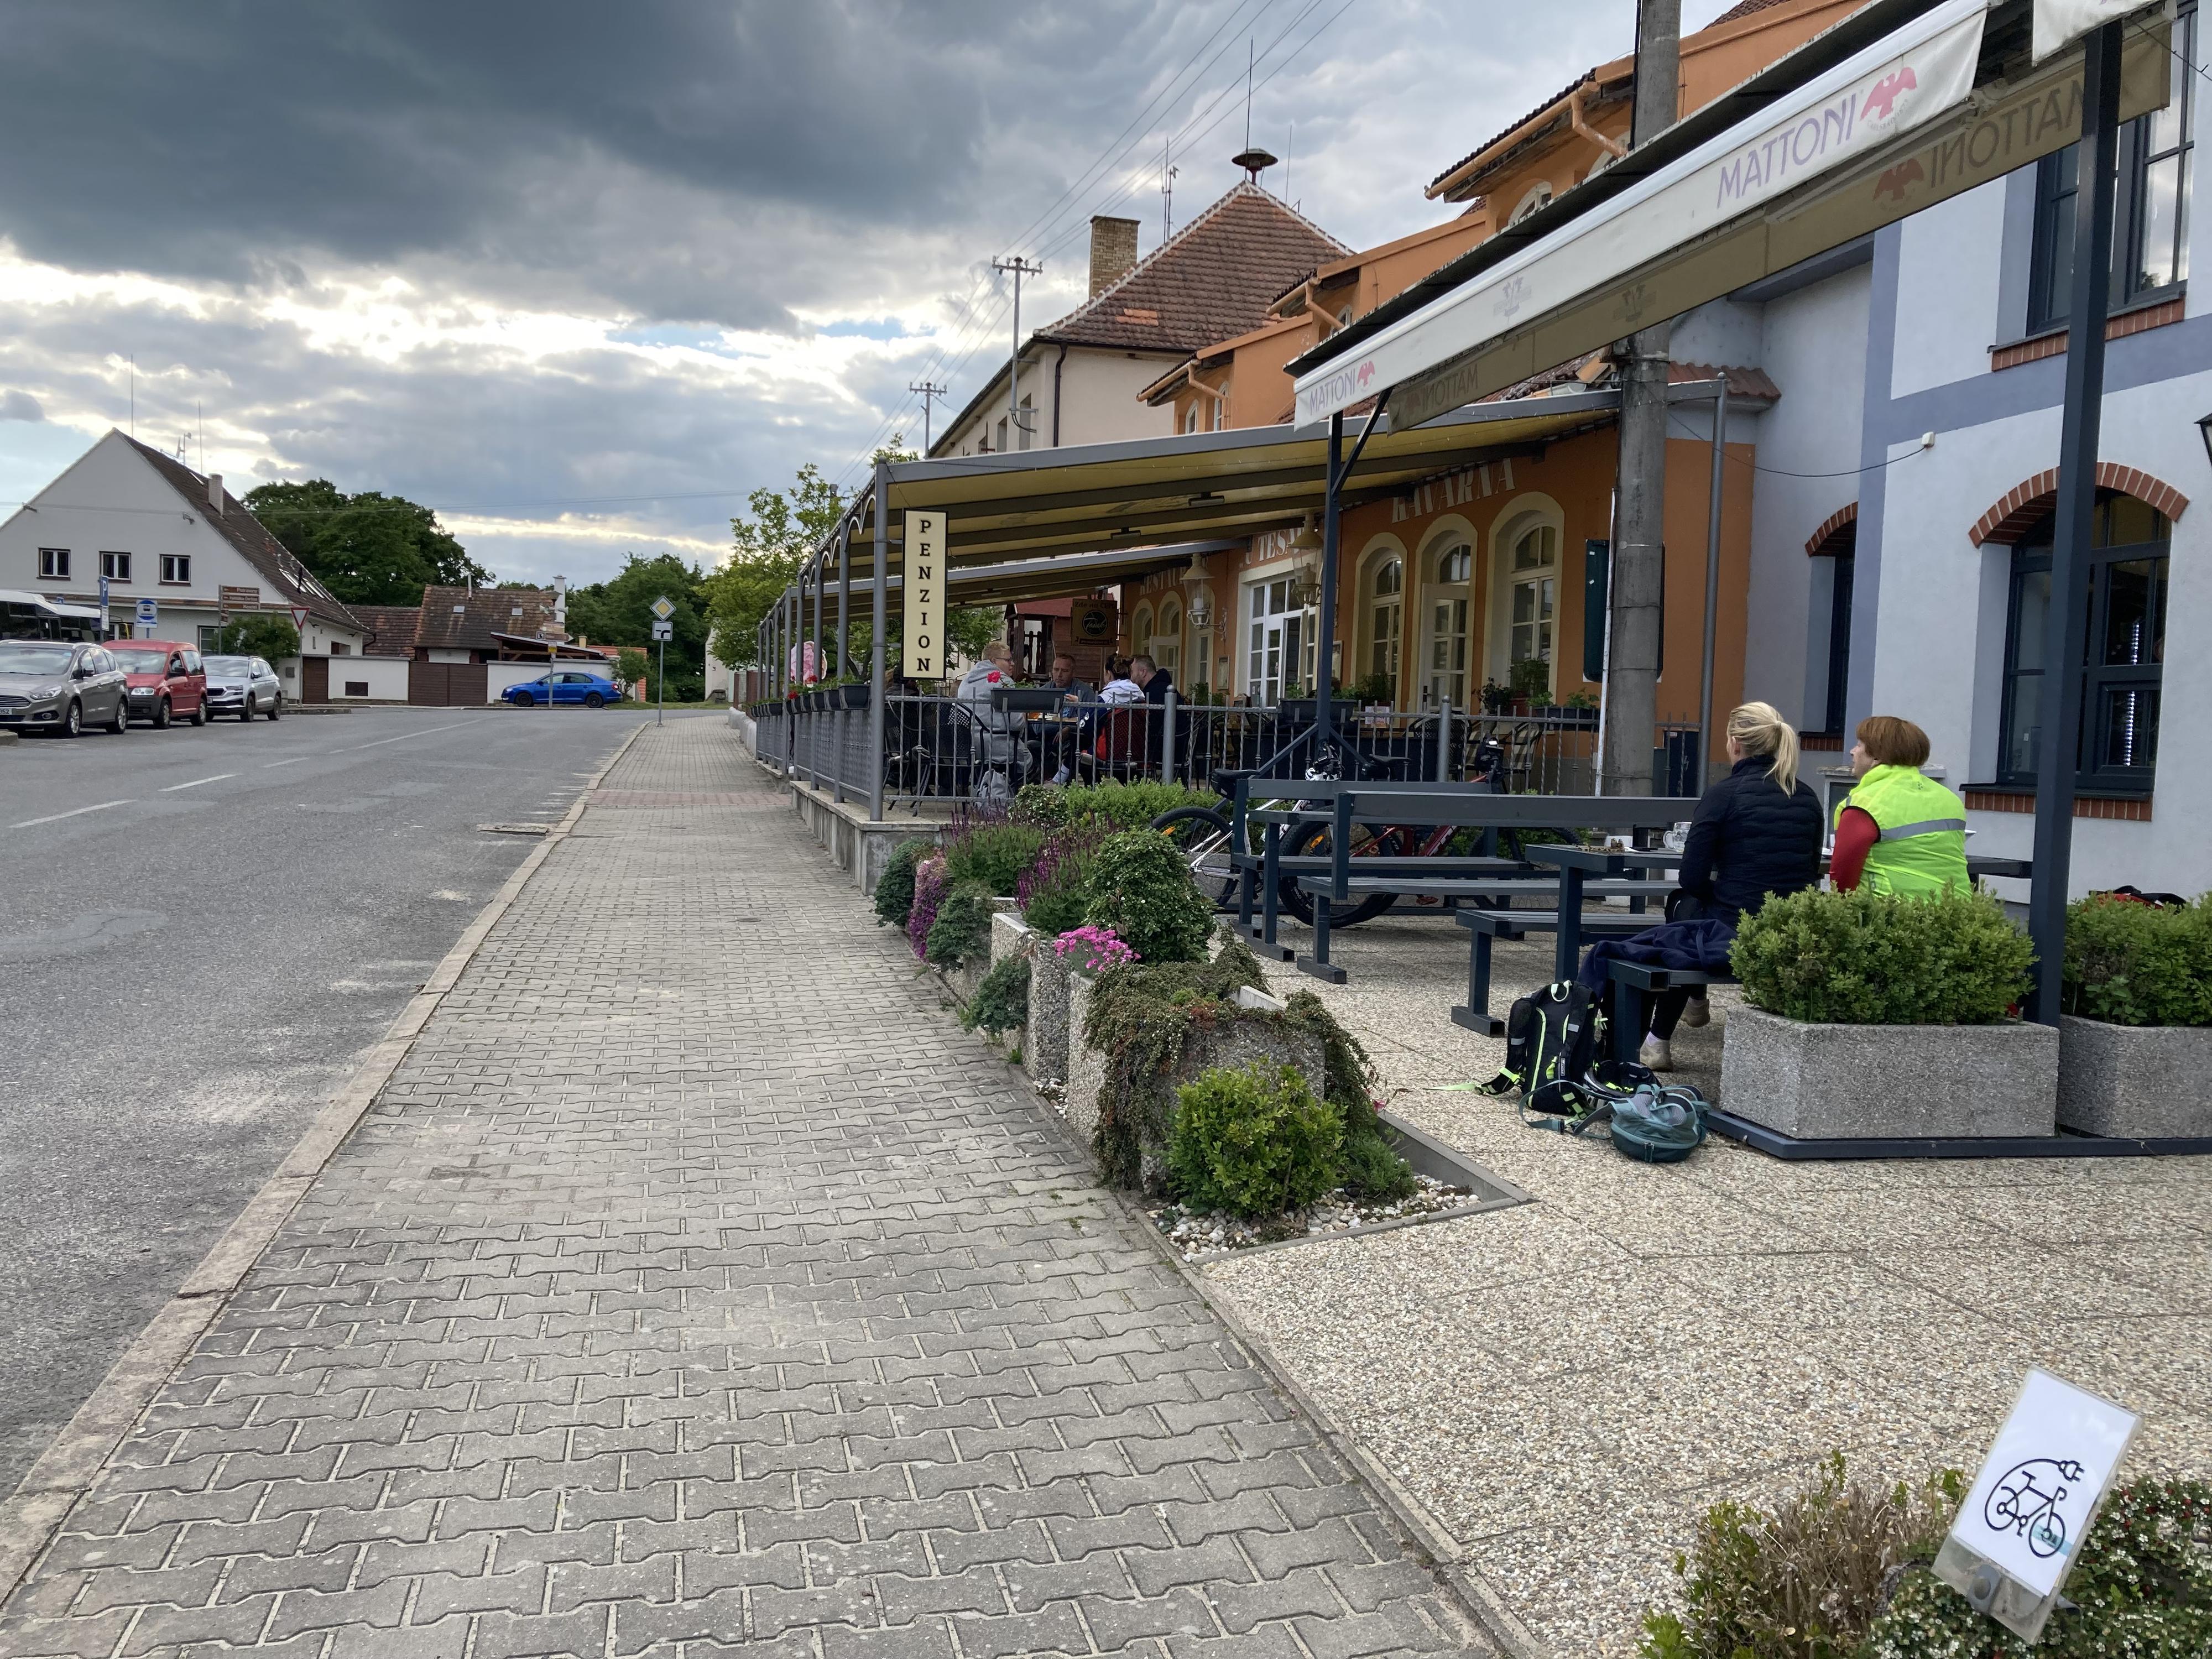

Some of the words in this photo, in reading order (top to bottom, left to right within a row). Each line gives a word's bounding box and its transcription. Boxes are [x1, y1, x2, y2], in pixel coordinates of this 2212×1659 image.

[1717, 93, 1856, 209] MATTONI
[1310, 368, 1355, 416] MATTONI
[102, 580, 107, 597] P
[917, 520, 931, 671] PENZION
